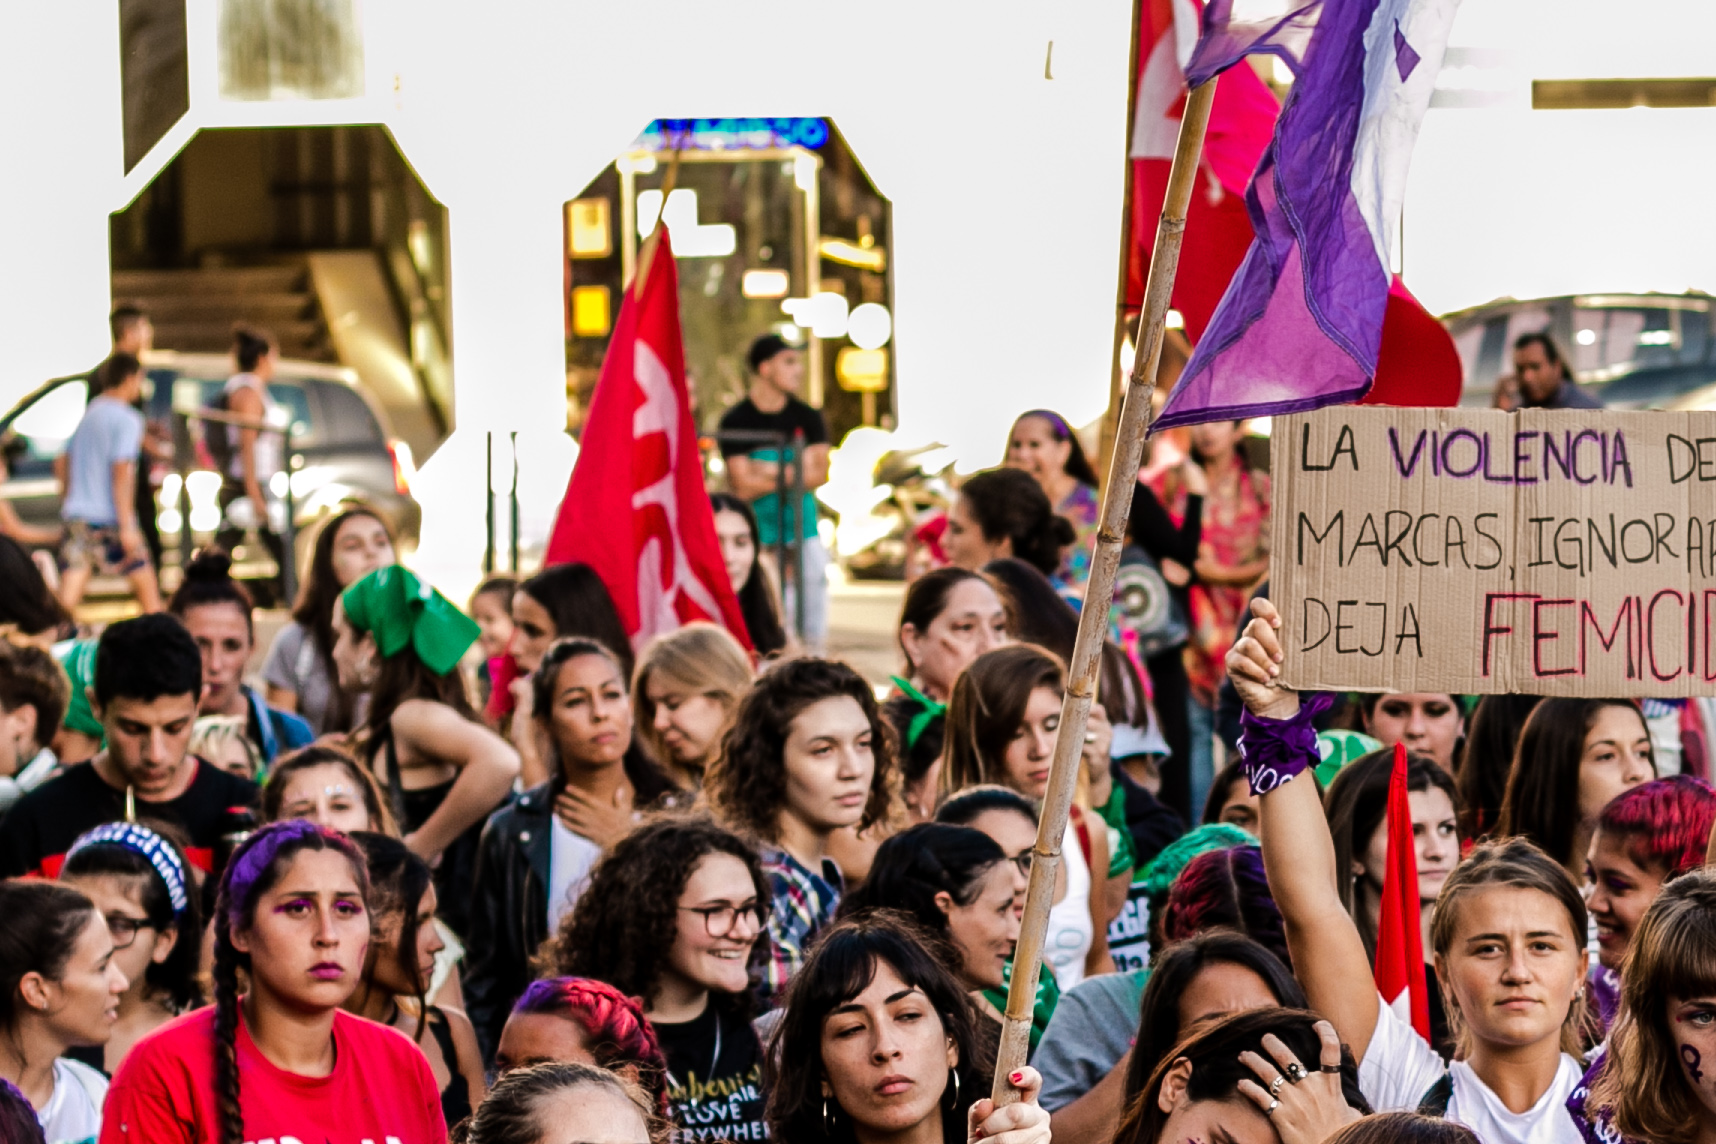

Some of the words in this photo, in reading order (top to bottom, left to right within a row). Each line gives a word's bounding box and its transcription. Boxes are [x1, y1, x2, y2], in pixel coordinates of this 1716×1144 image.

[1302, 422, 1358, 471] LA
[1387, 426, 1633, 489] VIOLENCIA
[1298, 510, 1515, 580] MARCAS,
[1301, 598, 1423, 658] DEJA
